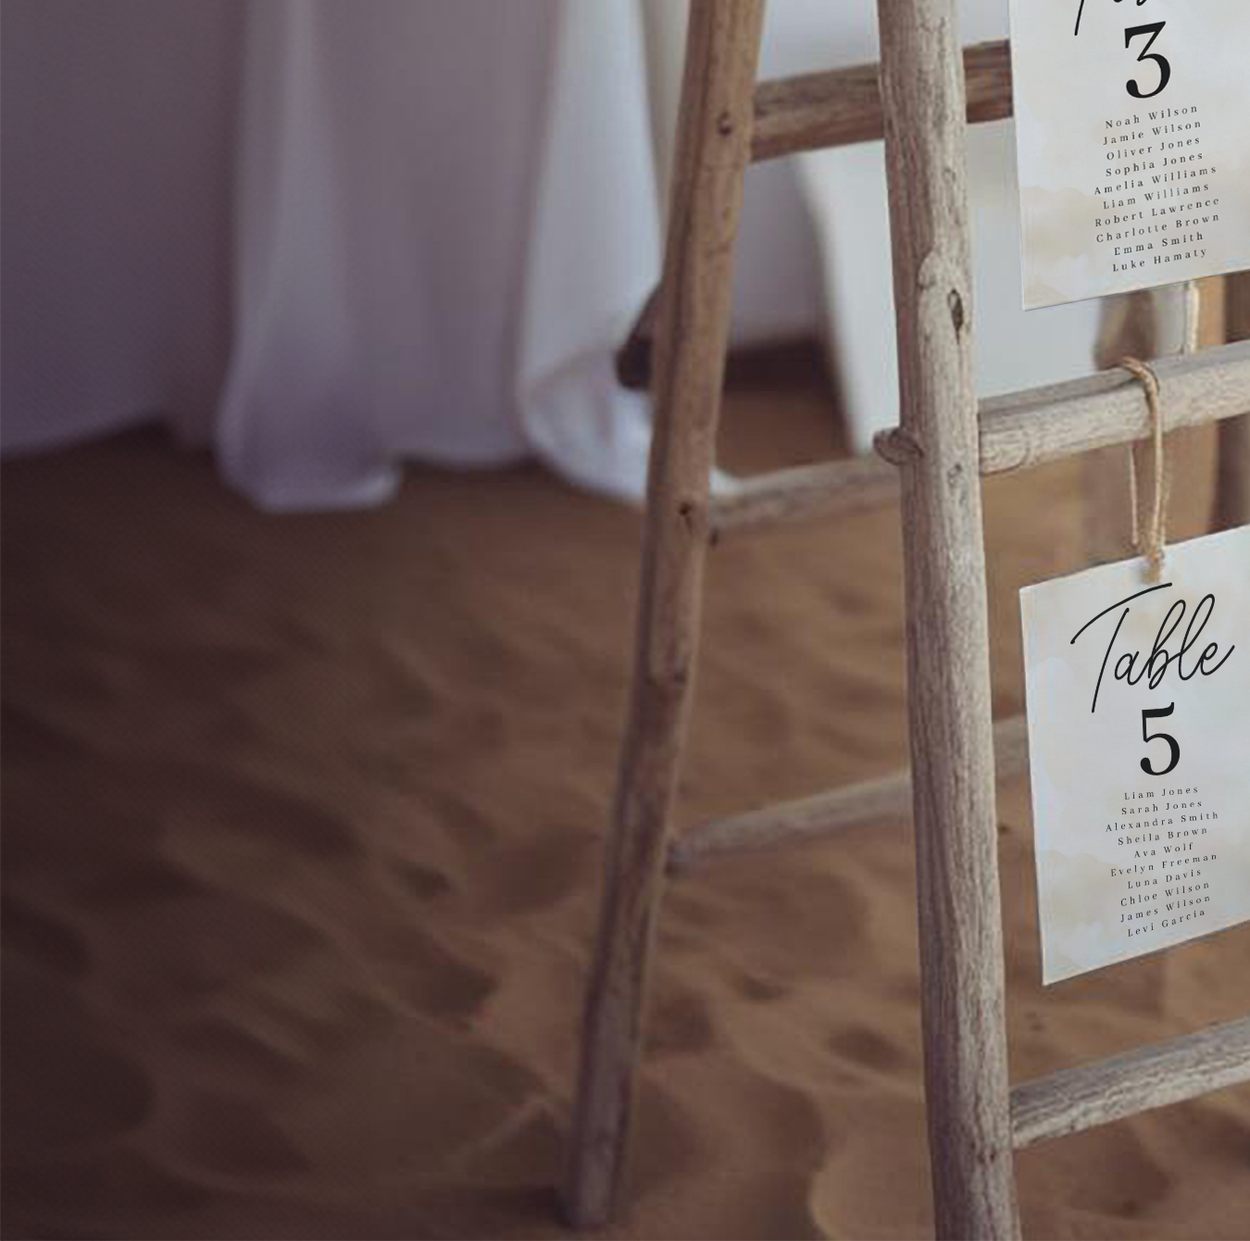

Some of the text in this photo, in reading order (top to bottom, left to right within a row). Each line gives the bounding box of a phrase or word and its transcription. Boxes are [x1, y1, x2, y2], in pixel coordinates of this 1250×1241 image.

[1123, 20, 1172, 99] 3
[1105, 106, 1197, 129] Noah Wilson
[1103, 121, 1201, 146] Jamie Wilson
[1106, 137, 1200, 161] Oliver Jones
[1105, 153, 1203, 177] Sophia Jones
[1094, 167, 1216, 195] Amelia Williams
[1103, 184, 1209, 210] Liam Williams
[1095, 198, 1219, 227] Robert Lawrence
[1096, 214, 1219, 243] Charlotte Brown
[1114, 231, 1203, 256] Emma Smith
[1112, 249, 1206, 272] Luke Hamaty
[1070, 582, 1236, 713] Table
[1140, 701, 1181, 776] 5
[1124, 787, 1198, 800] Liam Jones
[1121, 801, 1202, 815] Sarah Jones
[1106, 811, 1218, 832] Alexandra Smith
[1118, 828, 1207, 846] Sheila Brown
[1134, 842, 1193, 858] Ava Wolf
[1111, 854, 1217, 877] Evelyn Freeman
[1127, 869, 1201, 889] Luna Davis
[1120, 882, 1209, 907] Chloe Wilson
[1120, 896, 1210, 923] James Wilson
[1127, 910, 1205, 937] Levi Garcia
